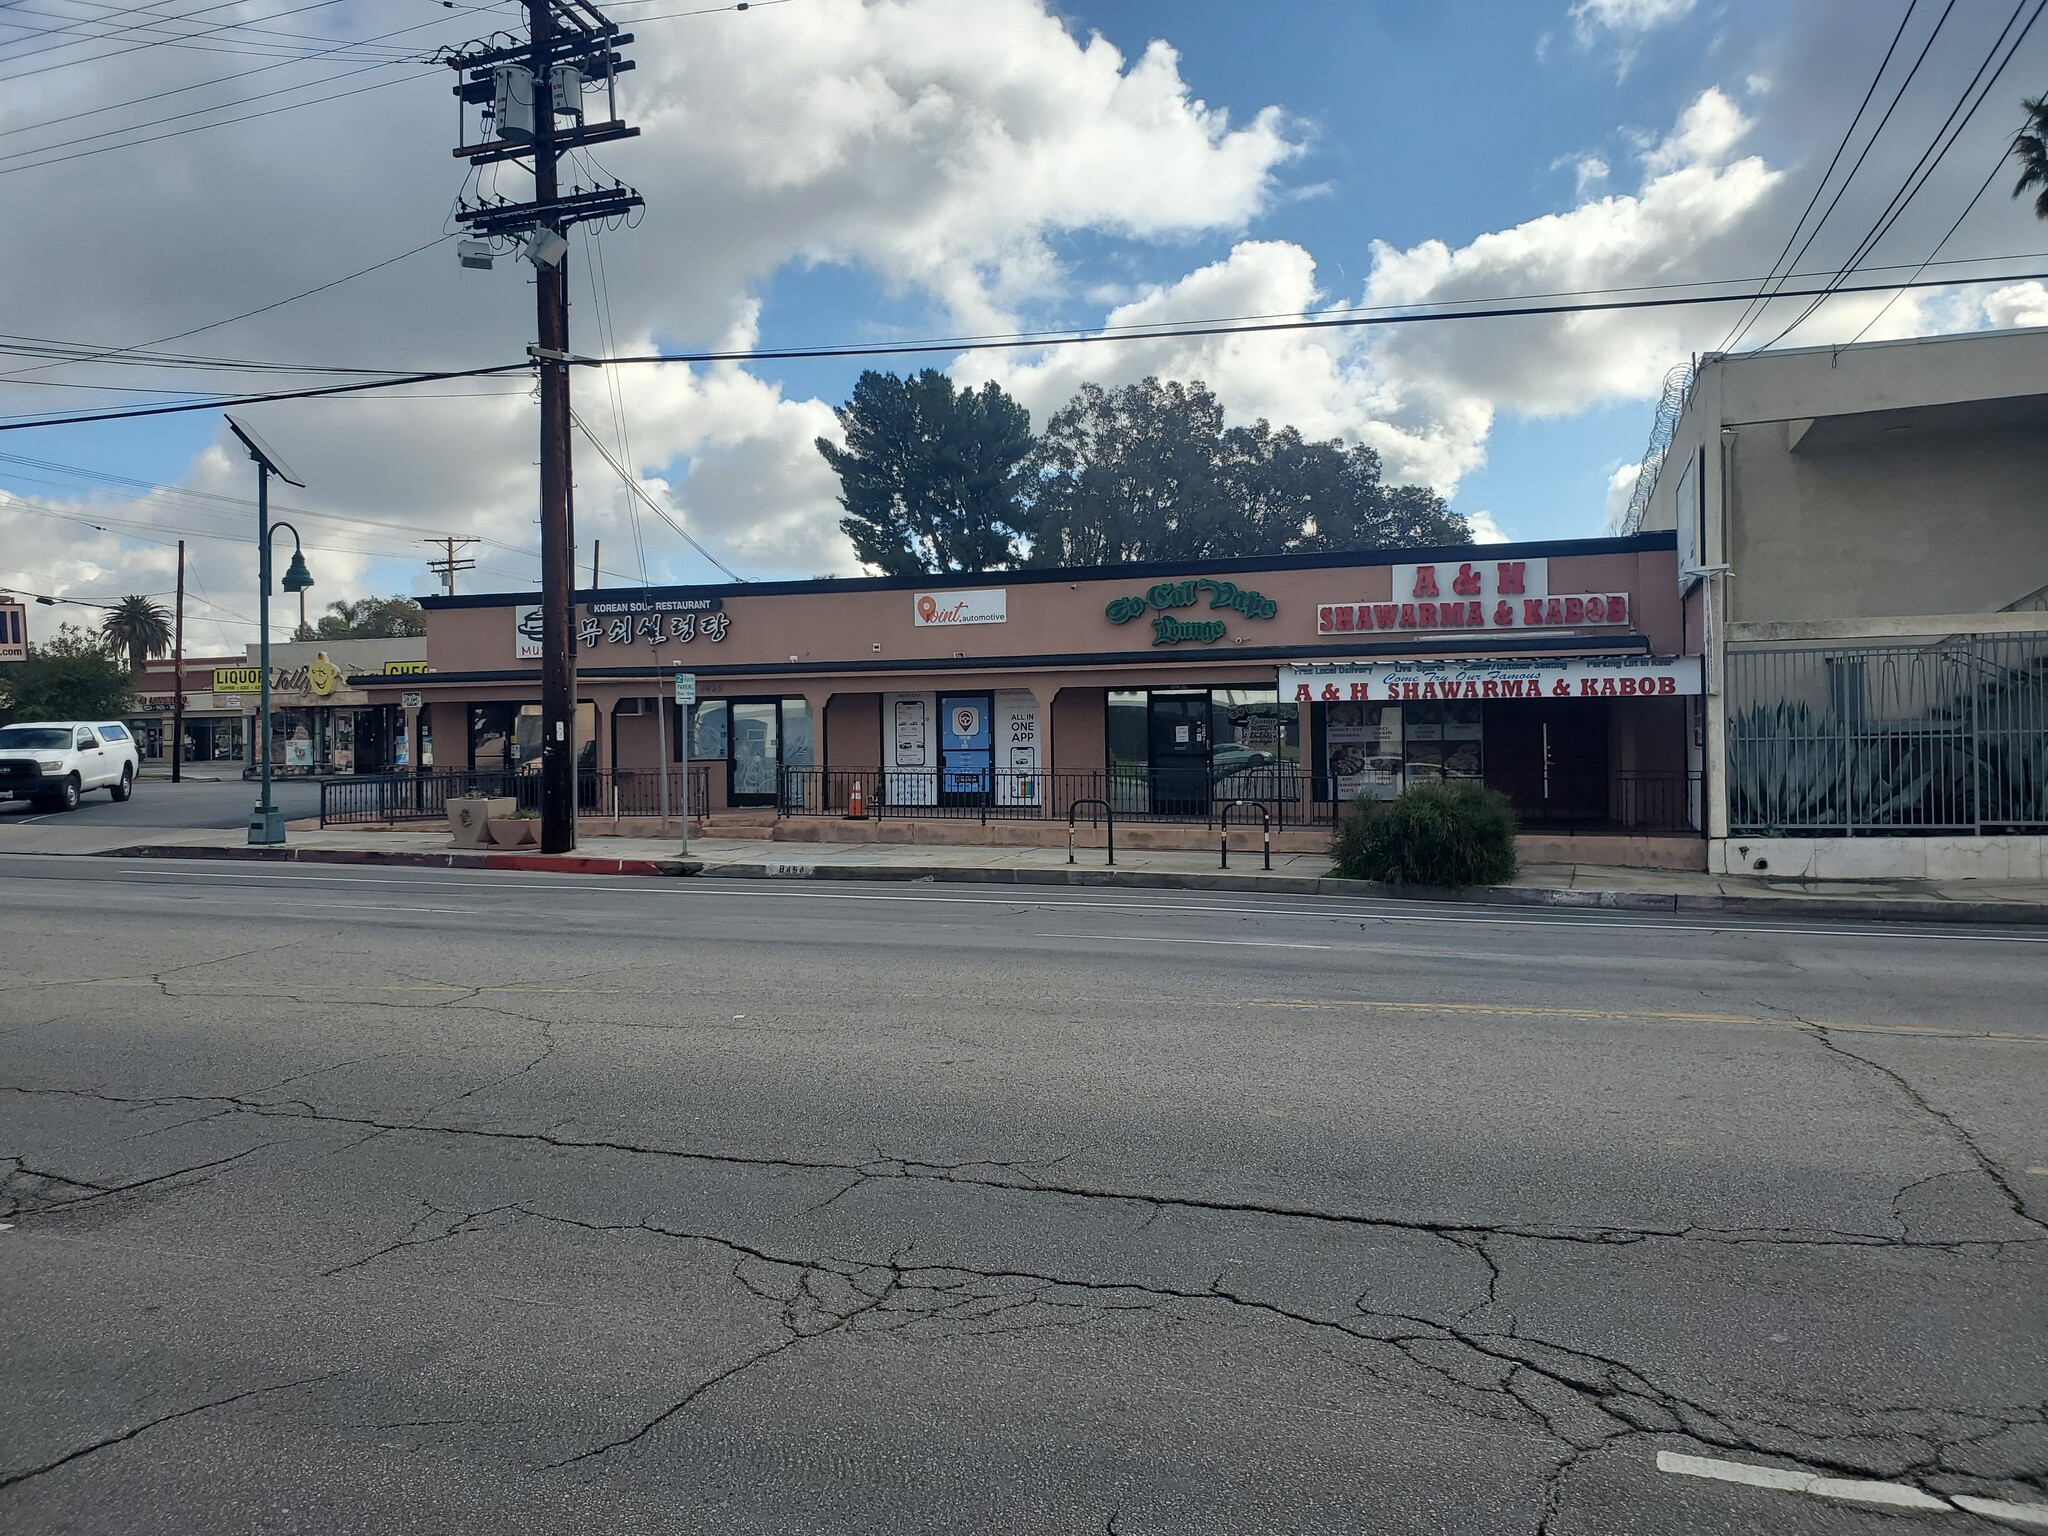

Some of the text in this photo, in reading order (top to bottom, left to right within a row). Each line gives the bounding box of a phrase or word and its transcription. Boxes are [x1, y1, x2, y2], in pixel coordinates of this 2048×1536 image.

[1412, 561, 1526, 598] A & H
[593, 602, 628, 613] KOREAN
[655, 600, 711, 611] RESTAURANT
[1105, 578, 1277, 624] So Cal Vape
[1319, 596, 1626, 632] SHAWARMA & KABOB
[1151, 615, 1227, 646] Lounge
[521, 645, 543, 656] MU
[1315, 666, 1337, 675] Local
[1338, 666, 1374, 675] Delivery
[1394, 665, 1412, 673] Live
[1416, 664, 1446, 673] Sports
[1534, 661, 1568, 671] Seating
[1586, 659, 1621, 669] Parking
[1623, 659, 1639, 667] Lot
[677, 674, 684, 683] 2
[1382, 670, 1542, 685] Come Try Our Famous
[1294, 676, 1677, 701] A & H SHAWARMA & KABOB
[1010, 713, 1034, 721] ALL IN
[1011, 721, 1035, 731] ONE
[1011, 732, 1034, 742] APP
